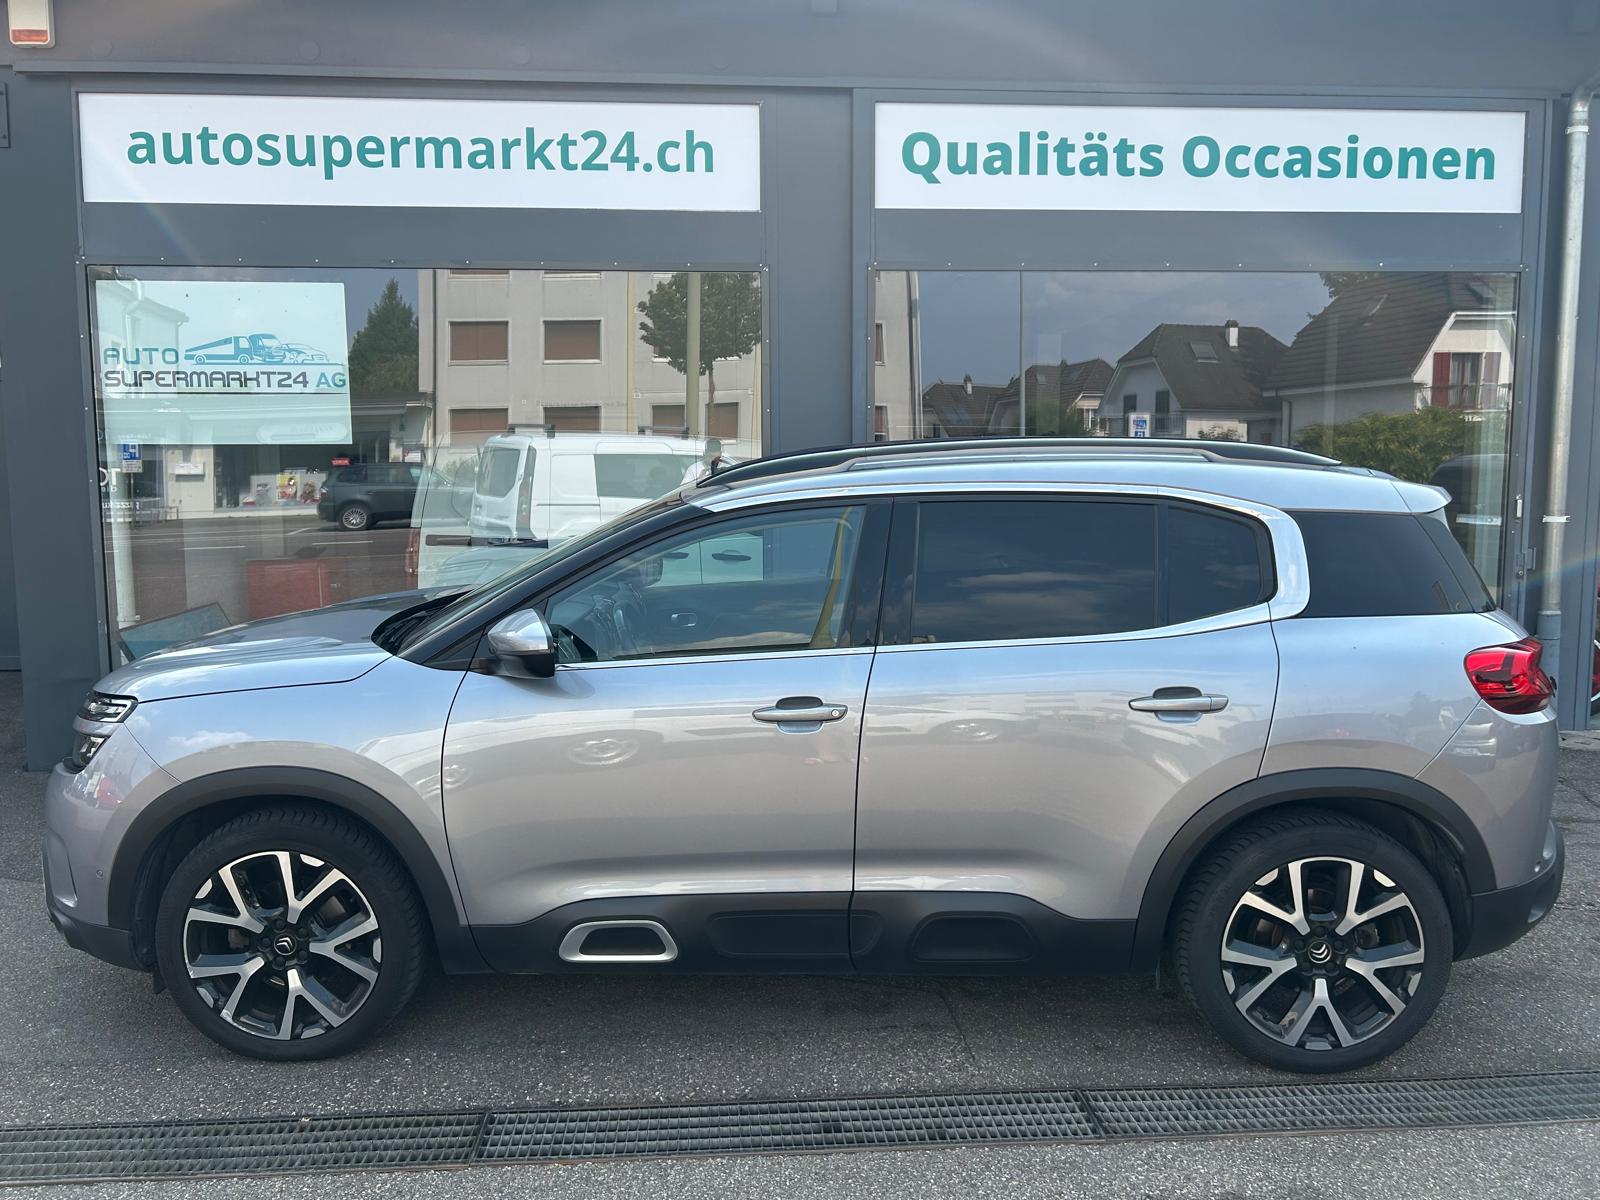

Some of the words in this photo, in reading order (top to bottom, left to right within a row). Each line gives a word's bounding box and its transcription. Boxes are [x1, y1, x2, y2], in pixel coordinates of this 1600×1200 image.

[127, 127, 714, 181] autosupermarkt24.ch
[901, 131, 1164, 184] Qualitäts
[1182, 135, 1495, 180] Occasionen
[103, 347, 179, 365] AUTO
[104, 370, 309, 388] SUPERMARKT24
[316, 372, 346, 388] AG
